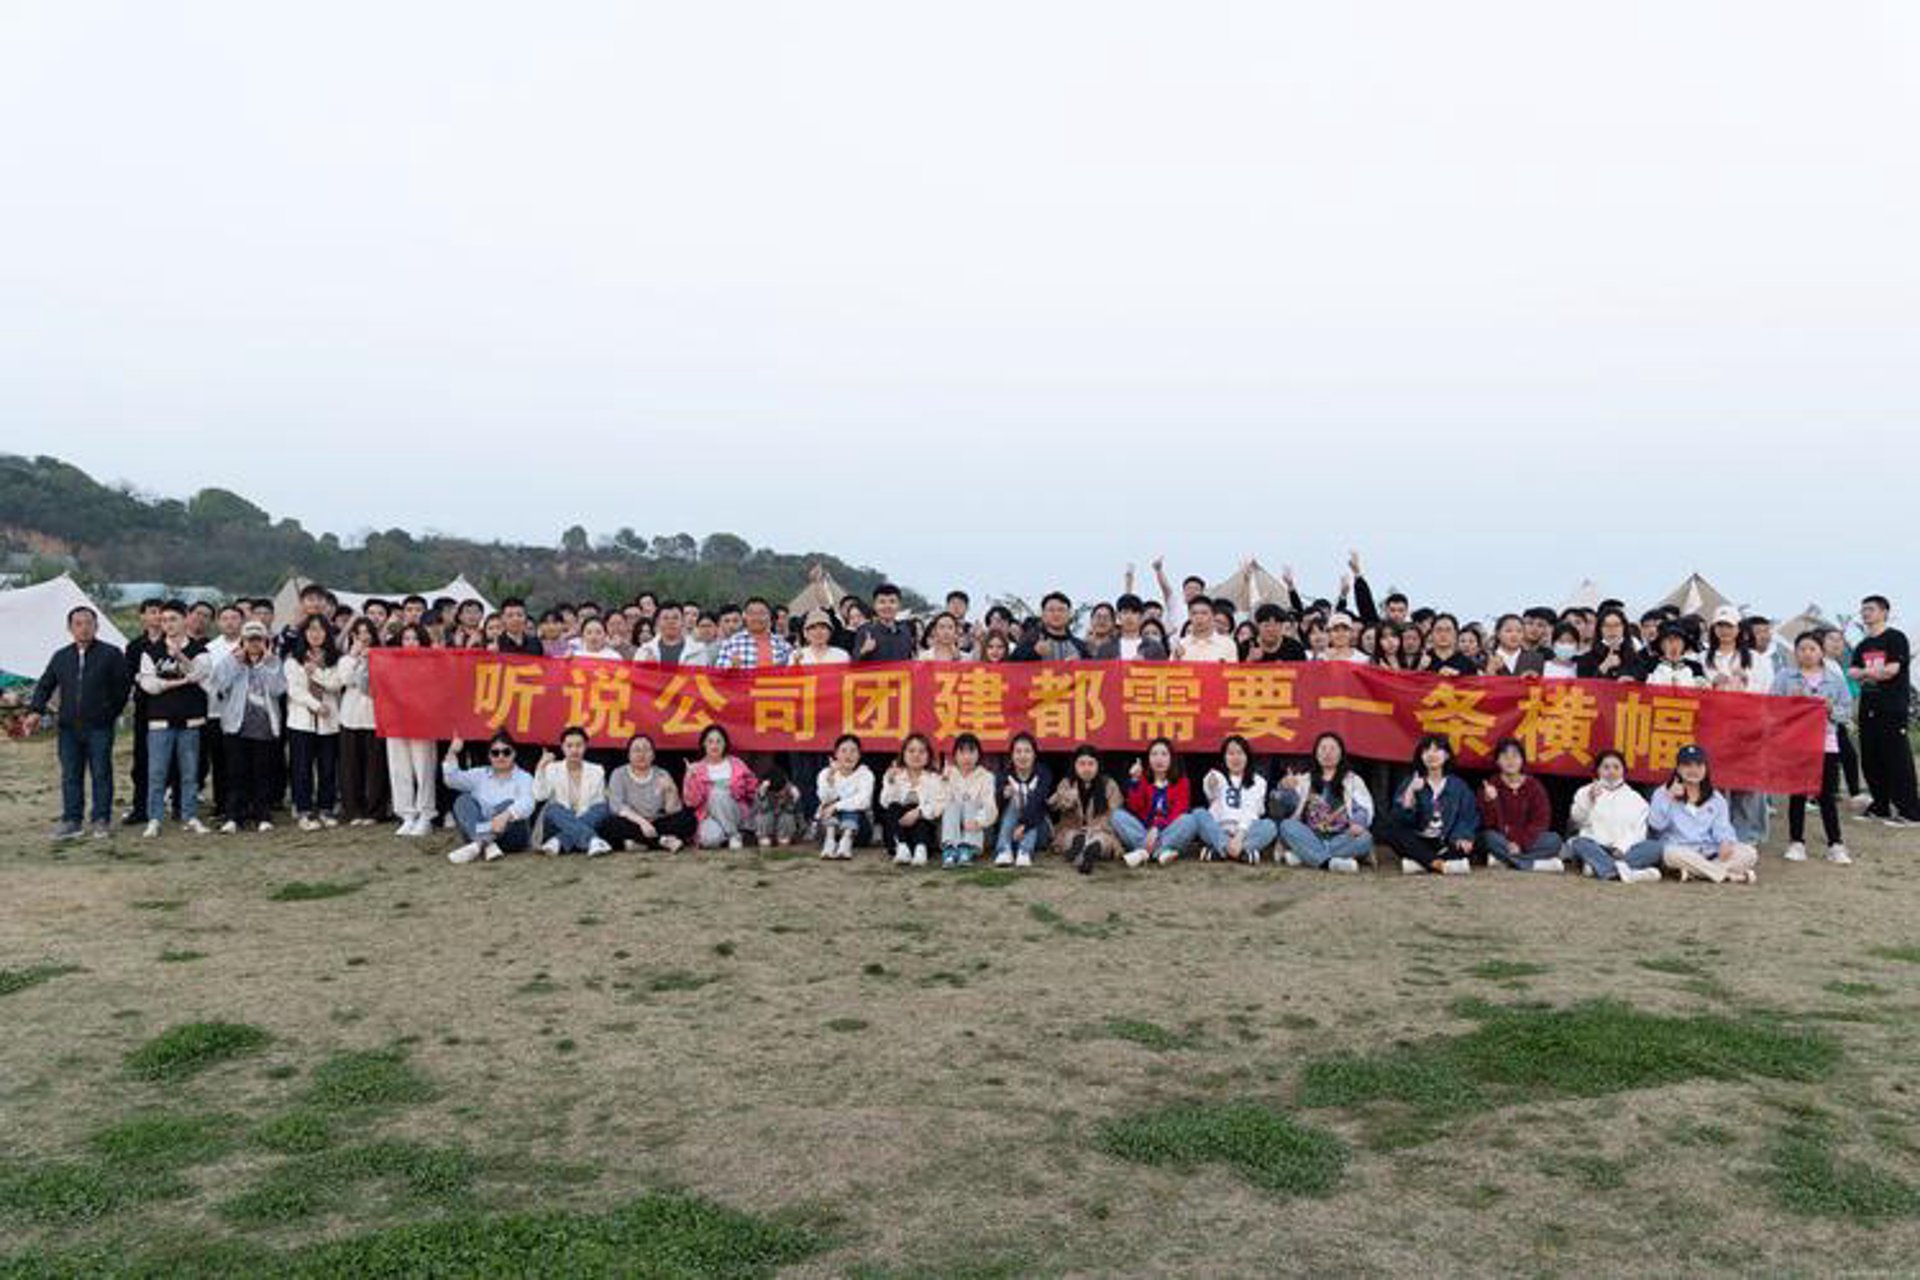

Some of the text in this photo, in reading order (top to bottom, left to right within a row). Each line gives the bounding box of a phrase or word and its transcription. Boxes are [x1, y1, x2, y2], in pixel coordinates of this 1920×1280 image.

[473, 662, 1700, 769] 听说公司团建都需要一条横幅
